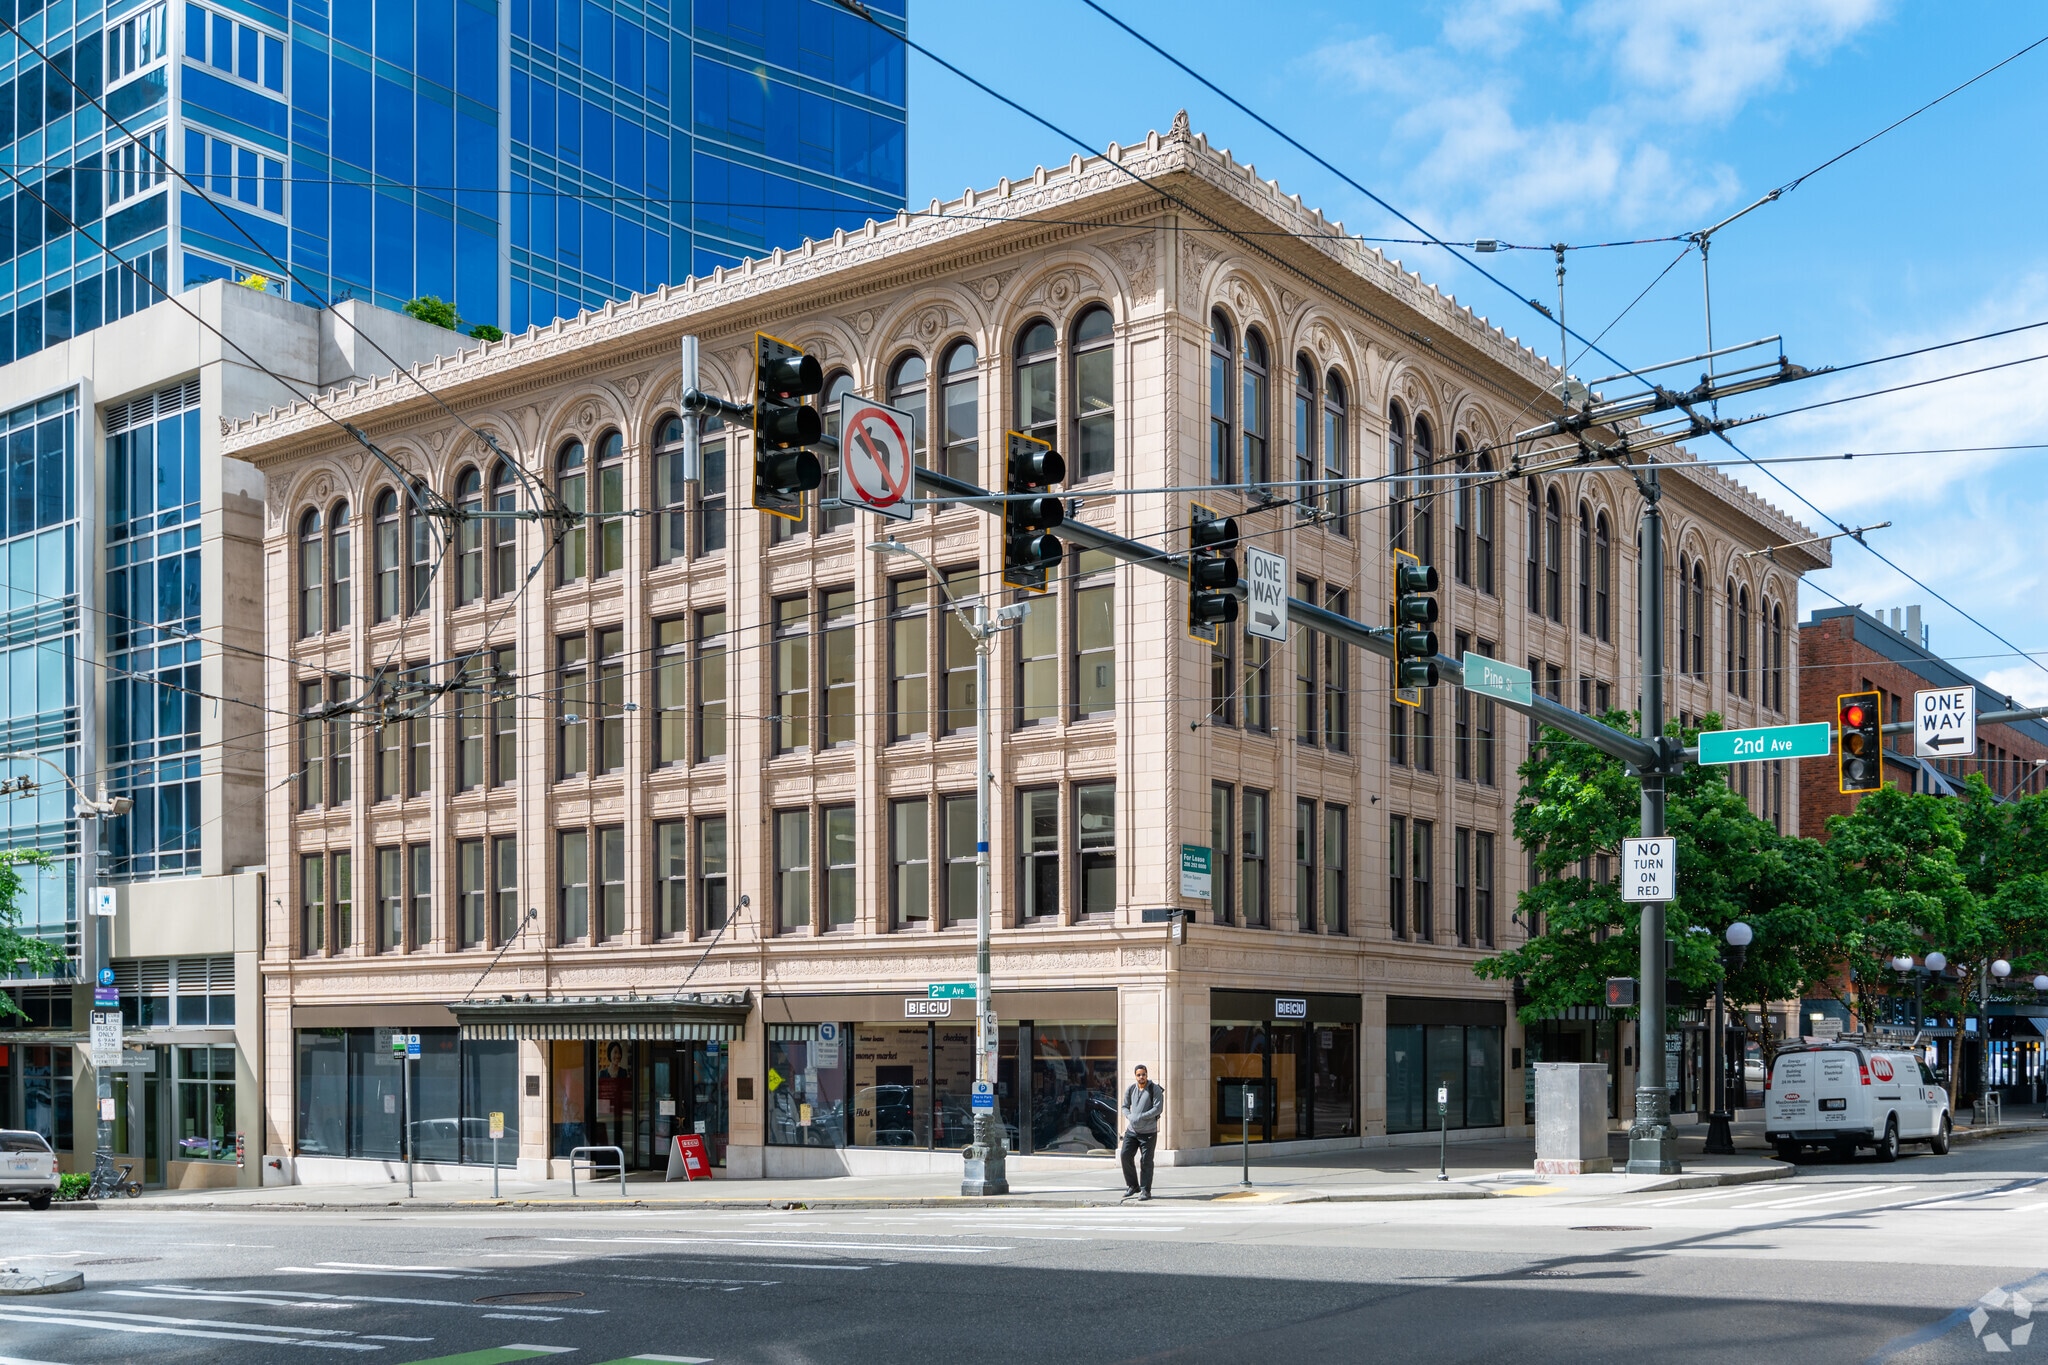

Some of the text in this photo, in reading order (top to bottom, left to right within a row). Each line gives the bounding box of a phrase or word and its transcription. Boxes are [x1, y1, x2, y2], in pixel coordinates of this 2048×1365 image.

[1254, 556, 1281, 583] ONE
[1253, 579, 1282, 607] WAY
[1484, 666, 1513, 693] Pine St
[1925, 693, 1965, 712] ONE
[1923, 711, 1966, 731] WAY
[1733, 736, 1793, 755] 2nd Ave
[1637, 843, 1660, 856] NO
[1633, 859, 1664, 869] TURN
[1640, 872, 1656, 882] ON
[1637, 885, 1660, 896] RED
[931, 985, 945, 997] 2nd
[952, 987, 965, 995] Ave
[908, 1001, 948, 1014] BECU
[1278, 1002, 1304, 1014] BECU
[943, 1033, 968, 1043] checking
[856, 1051, 898, 1062] money market
